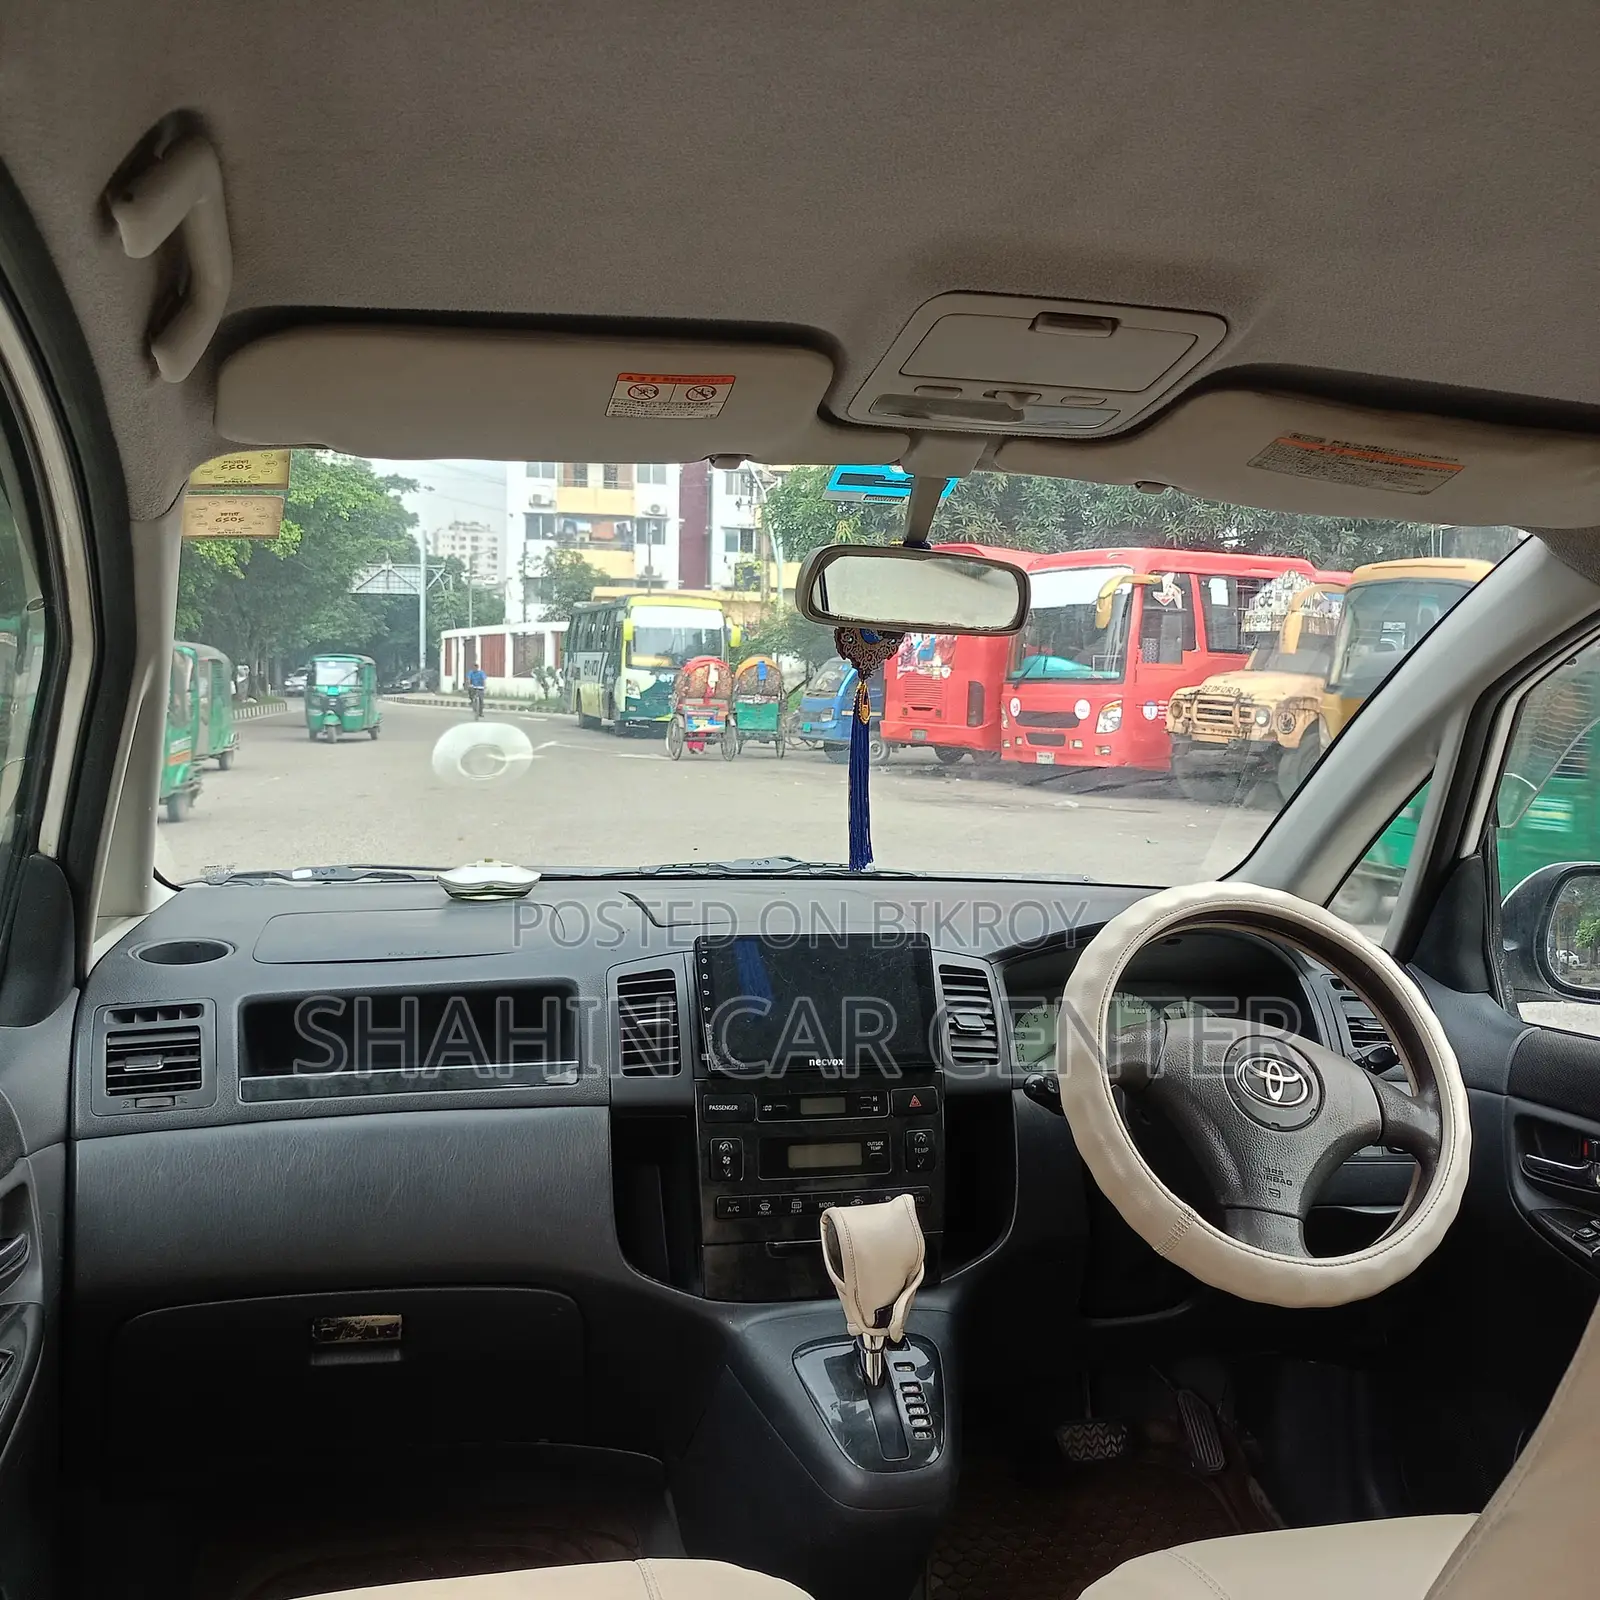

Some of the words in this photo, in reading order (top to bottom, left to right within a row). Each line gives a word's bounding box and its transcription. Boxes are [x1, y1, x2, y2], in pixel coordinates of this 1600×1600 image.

[808, 1057, 844, 1067] necvox
[708, 1103, 739, 1112] PASSENGER
[727, 1205, 740, 1213] A/C
